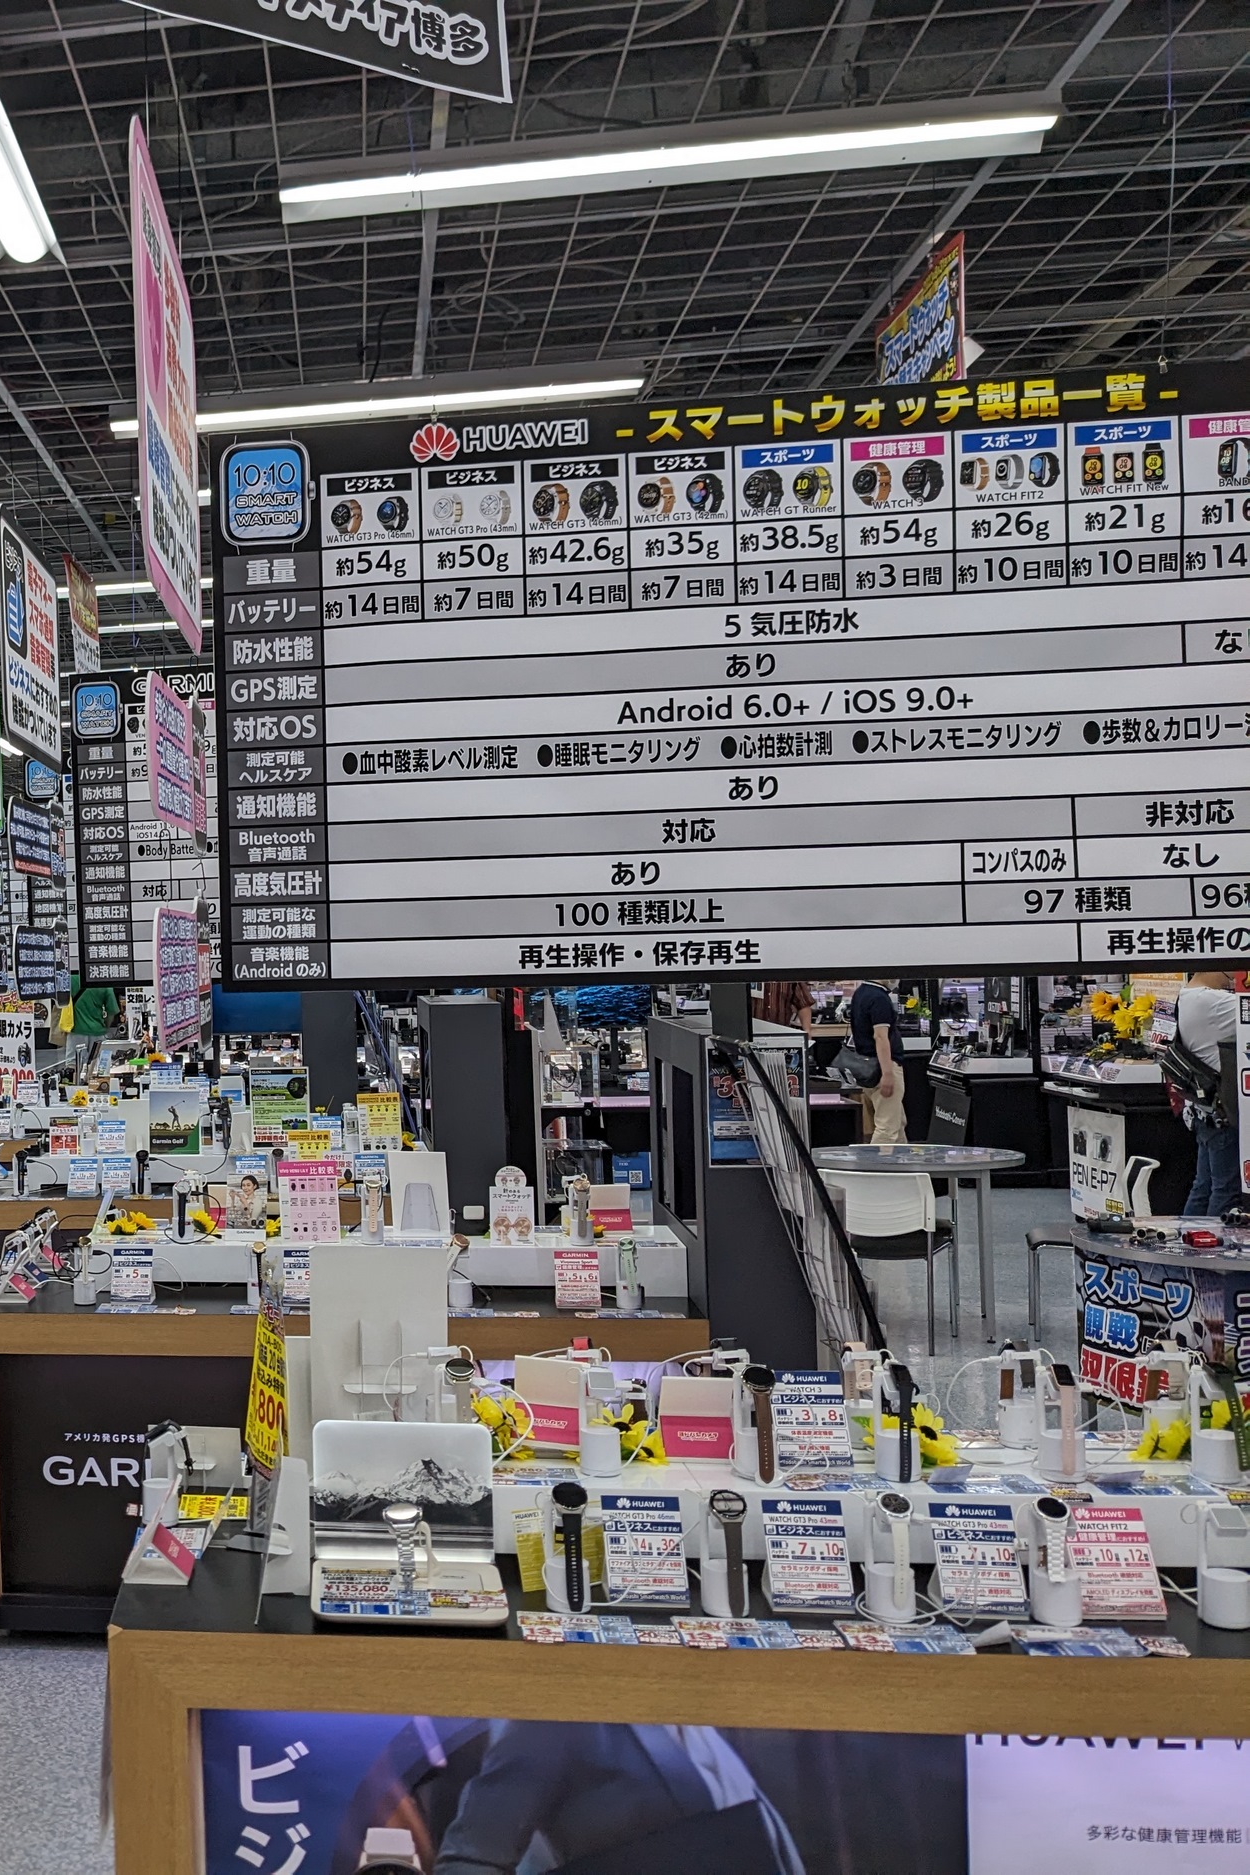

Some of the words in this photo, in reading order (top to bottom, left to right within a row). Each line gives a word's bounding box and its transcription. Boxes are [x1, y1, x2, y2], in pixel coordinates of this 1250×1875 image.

[646, 373, 1147, 443] スマートウォッチ製品一覧
[462, 418, 589, 453] HUAWEI
[980, 431, 1037, 450] スポーツ
[1093, 423, 1151, 442] スポーツ
[760, 447, 815, 464] スポーツ
[868, 439, 926, 457] 健康管理
[233, 462, 296, 487] 10:10
[446, 468, 498, 485] ビジネス
[549, 462, 602, 478] ビジネス
[344, 475, 395, 492] ビジネス
[236, 493, 296, 508] SMART
[873, 499, 913, 510] WATCH
[917, 498, 923, 507] 3
[976, 492, 1015, 502] WATCH
[1020, 491, 1044, 500] FIT2
[235, 510, 298, 525] WATCH
[741, 507, 780, 517] WATCH
[785, 506, 798, 515] GT
[803, 505, 836, 514] Runner
[1084, 504, 1166, 534] 約21g
[859, 517, 938, 547] 約54g
[970, 511, 1050, 541] 約26g
[644, 531, 720, 560] 約35g
[739, 523, 839, 553] 約38.5g
[335, 549, 407, 578] 約54g
[437, 543, 509, 571] 約50g
[528, 539, 624, 566] 約42.6g
[246, 559, 297, 585] 重量
[856, 562, 942, 591] 約3日間
[957, 556, 1064, 584] 約10日間
[324, 592, 420, 618] 約14日間
[433, 587, 514, 613] 約7日間
[228, 601, 316, 624] バッテリー
[232, 638, 314, 665] 防水性能
[725, 652, 777, 678] あり
[132, 672, 214, 696] GRMI
[230, 676, 317, 702] GPS測定
[233, 714, 316, 740] 対応OS
[246, 750, 305, 767] 測定可能
[80, 766, 123, 781] バッテリー
[239, 766, 313, 784] ヘルスケア
[82, 786, 122, 800] 防水性能
[728, 775, 780, 801] あり
[82, 805, 125, 820] GPS測定
[236, 793, 317, 819] 通知機能
[1145, 799, 1234, 828] 非対応
[83, 826, 125, 840] 対応OS
[238, 829, 316, 845] Bluetooth
[662, 818, 716, 844] 対応
[248, 845, 307, 861] 音声通話
[972, 848, 1067, 875] コンパスのみ
[1162, 843, 1220, 868] なし
[85, 865, 126, 879] 通知機能
[610, 860, 660, 886] あり
[233, 871, 322, 898] 高度気圧計
[242, 907, 316, 923] 測定可能な
[242, 923, 316, 939] 運動の種類
[88, 944, 129, 958] 音楽機能
[250, 946, 309, 961] 音楽機能
[518, 938, 762, 969] 再生操作・保存再生
[1073, 1162, 1088, 1186] PEN
[1091, 1169, 1117, 1193] E-P7
[1084, 1262, 1192, 1319] スポーツ
[796, 1375, 827, 1383] HUAWEI
[43, 1456, 150, 1487] GAR
[632, 1500, 664, 1508] HUAWEI
[793, 1504, 826, 1512] HUAWEI
[962, 1508, 996, 1516] HUAWEI
[798, 1542, 807, 1555] 7
[825, 1543, 839, 1555] 10
[1130, 1549, 1144, 1561] 12
[1087, 1825, 1242, 1843] 多彩な健康管理機能
